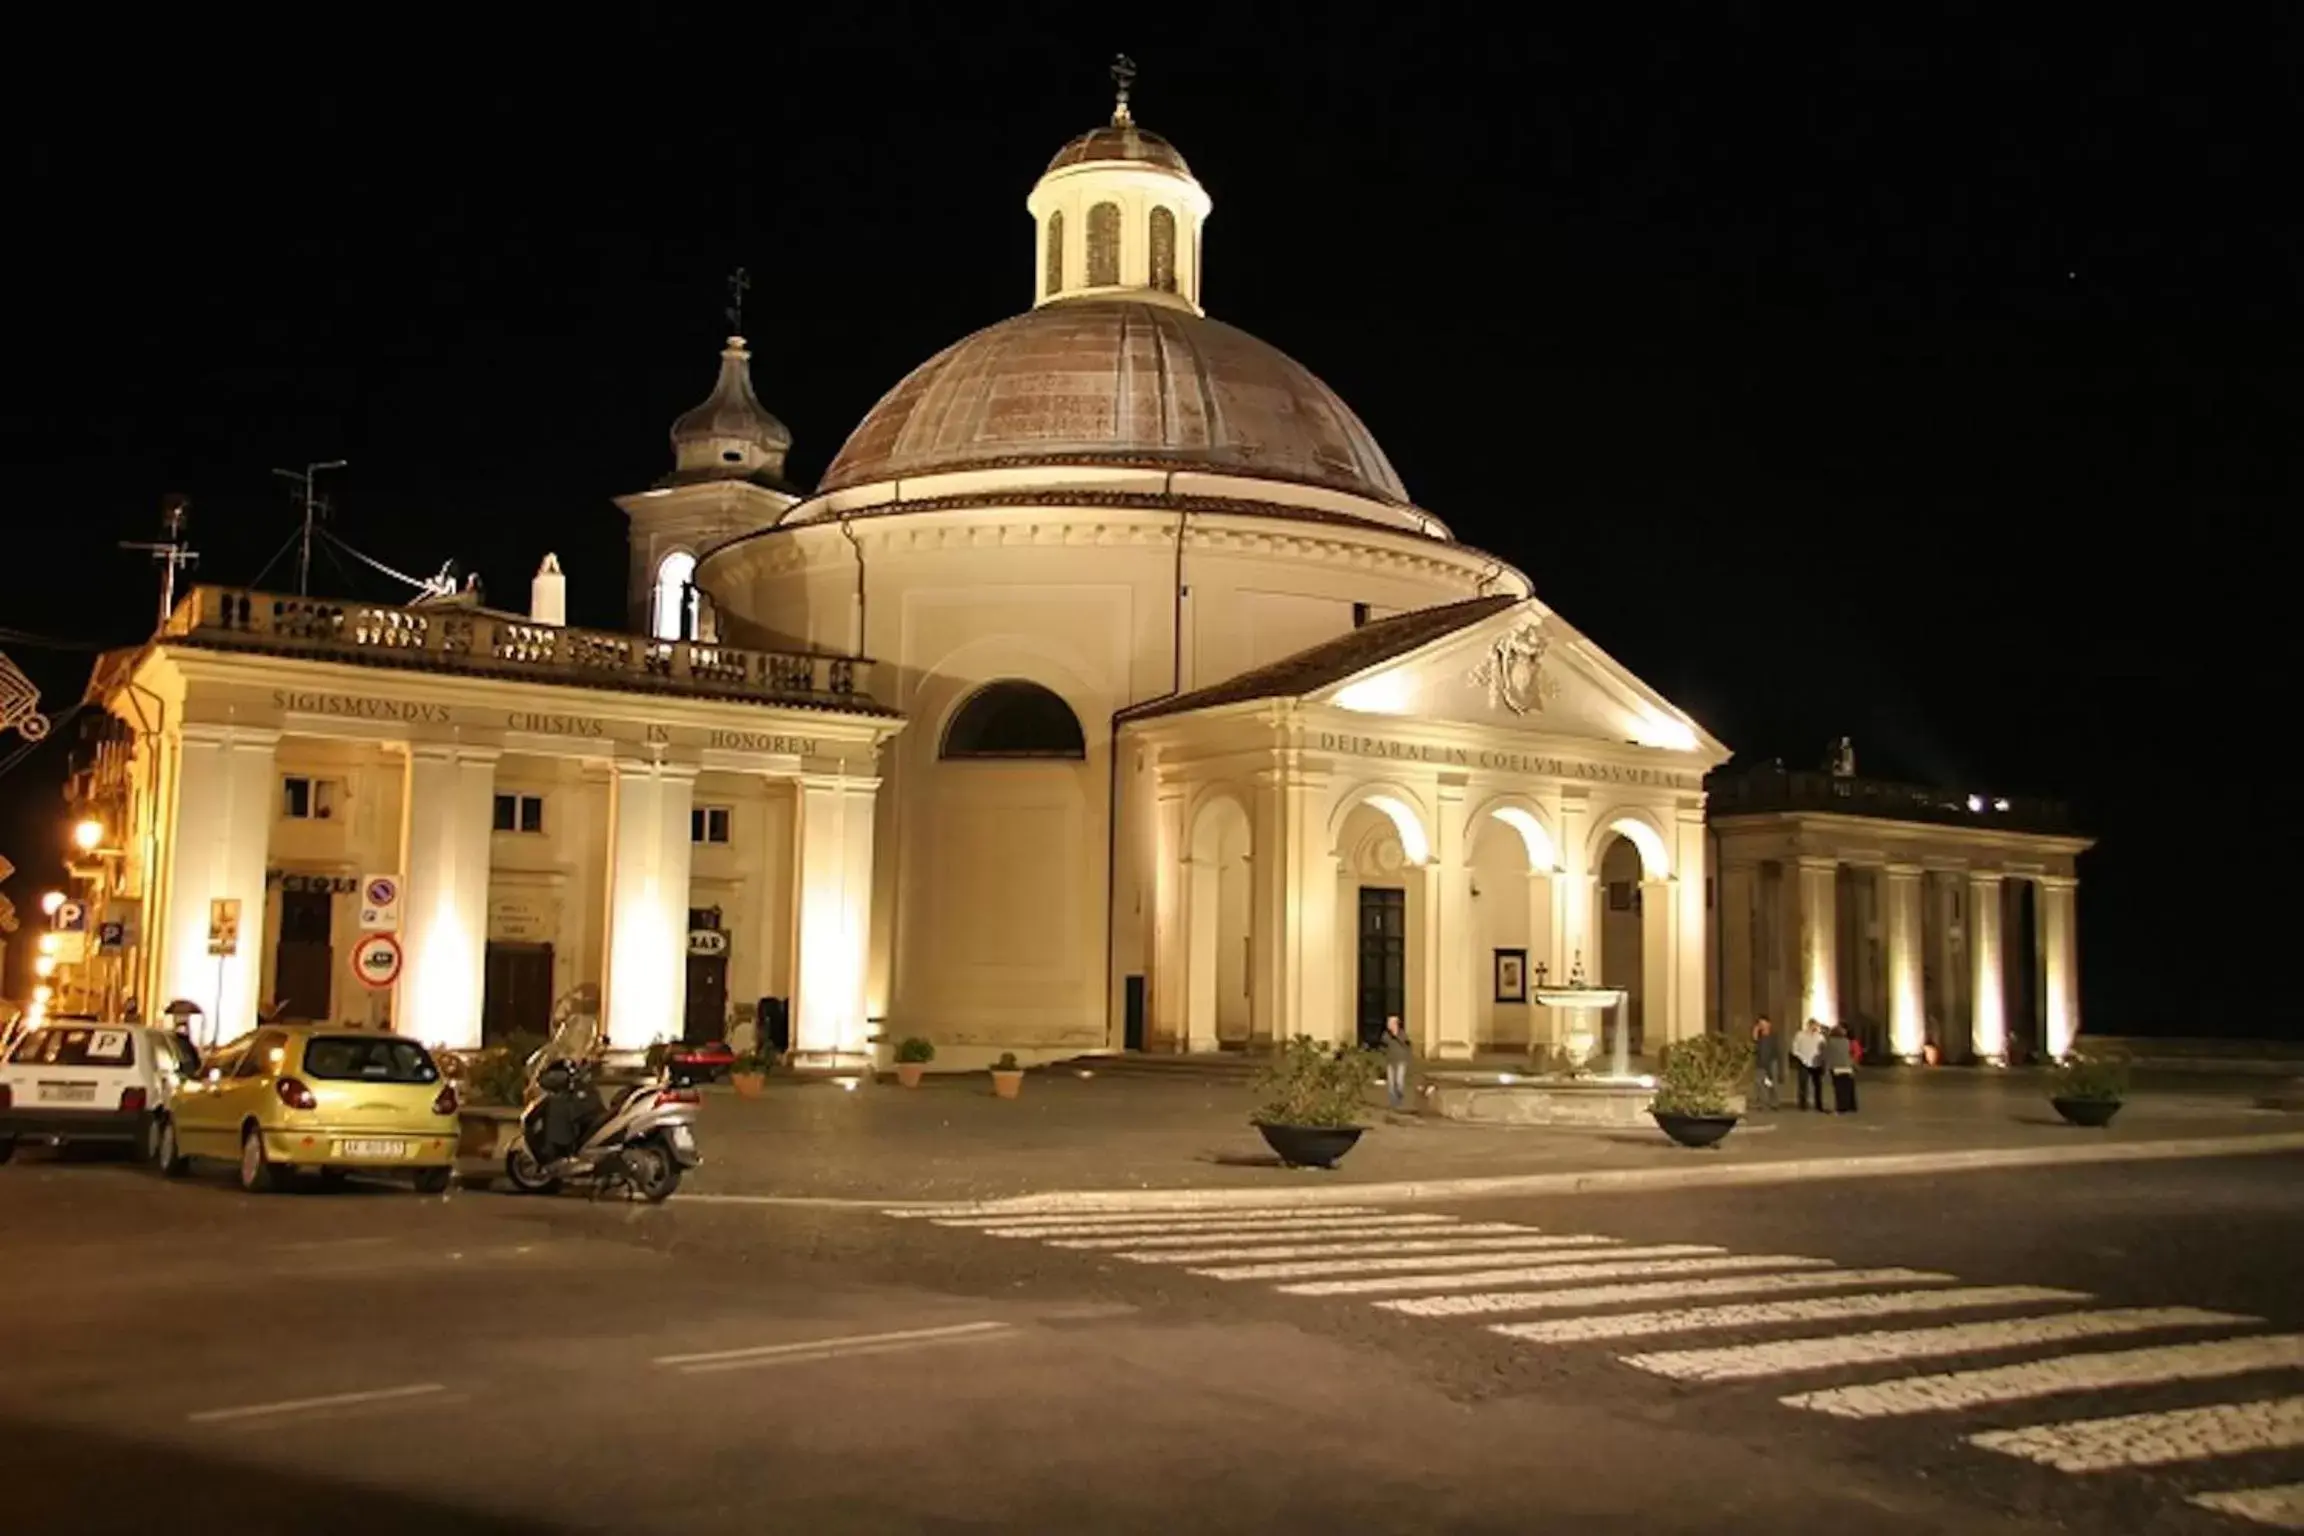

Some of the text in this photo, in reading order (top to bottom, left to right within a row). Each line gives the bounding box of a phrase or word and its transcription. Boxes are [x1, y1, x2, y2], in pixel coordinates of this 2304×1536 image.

[272, 689, 450, 722] SIGISMVNDVS
[647, 723, 669, 743] IN
[709, 729, 816, 756] HONOREM
[1321, 732, 1430, 761] DEIPARAE
[1446, 747, 1466, 765] IN
[1480, 752, 1563, 775] COELVM
[59, 903, 81, 929] P
[103, 926, 120, 943] P
